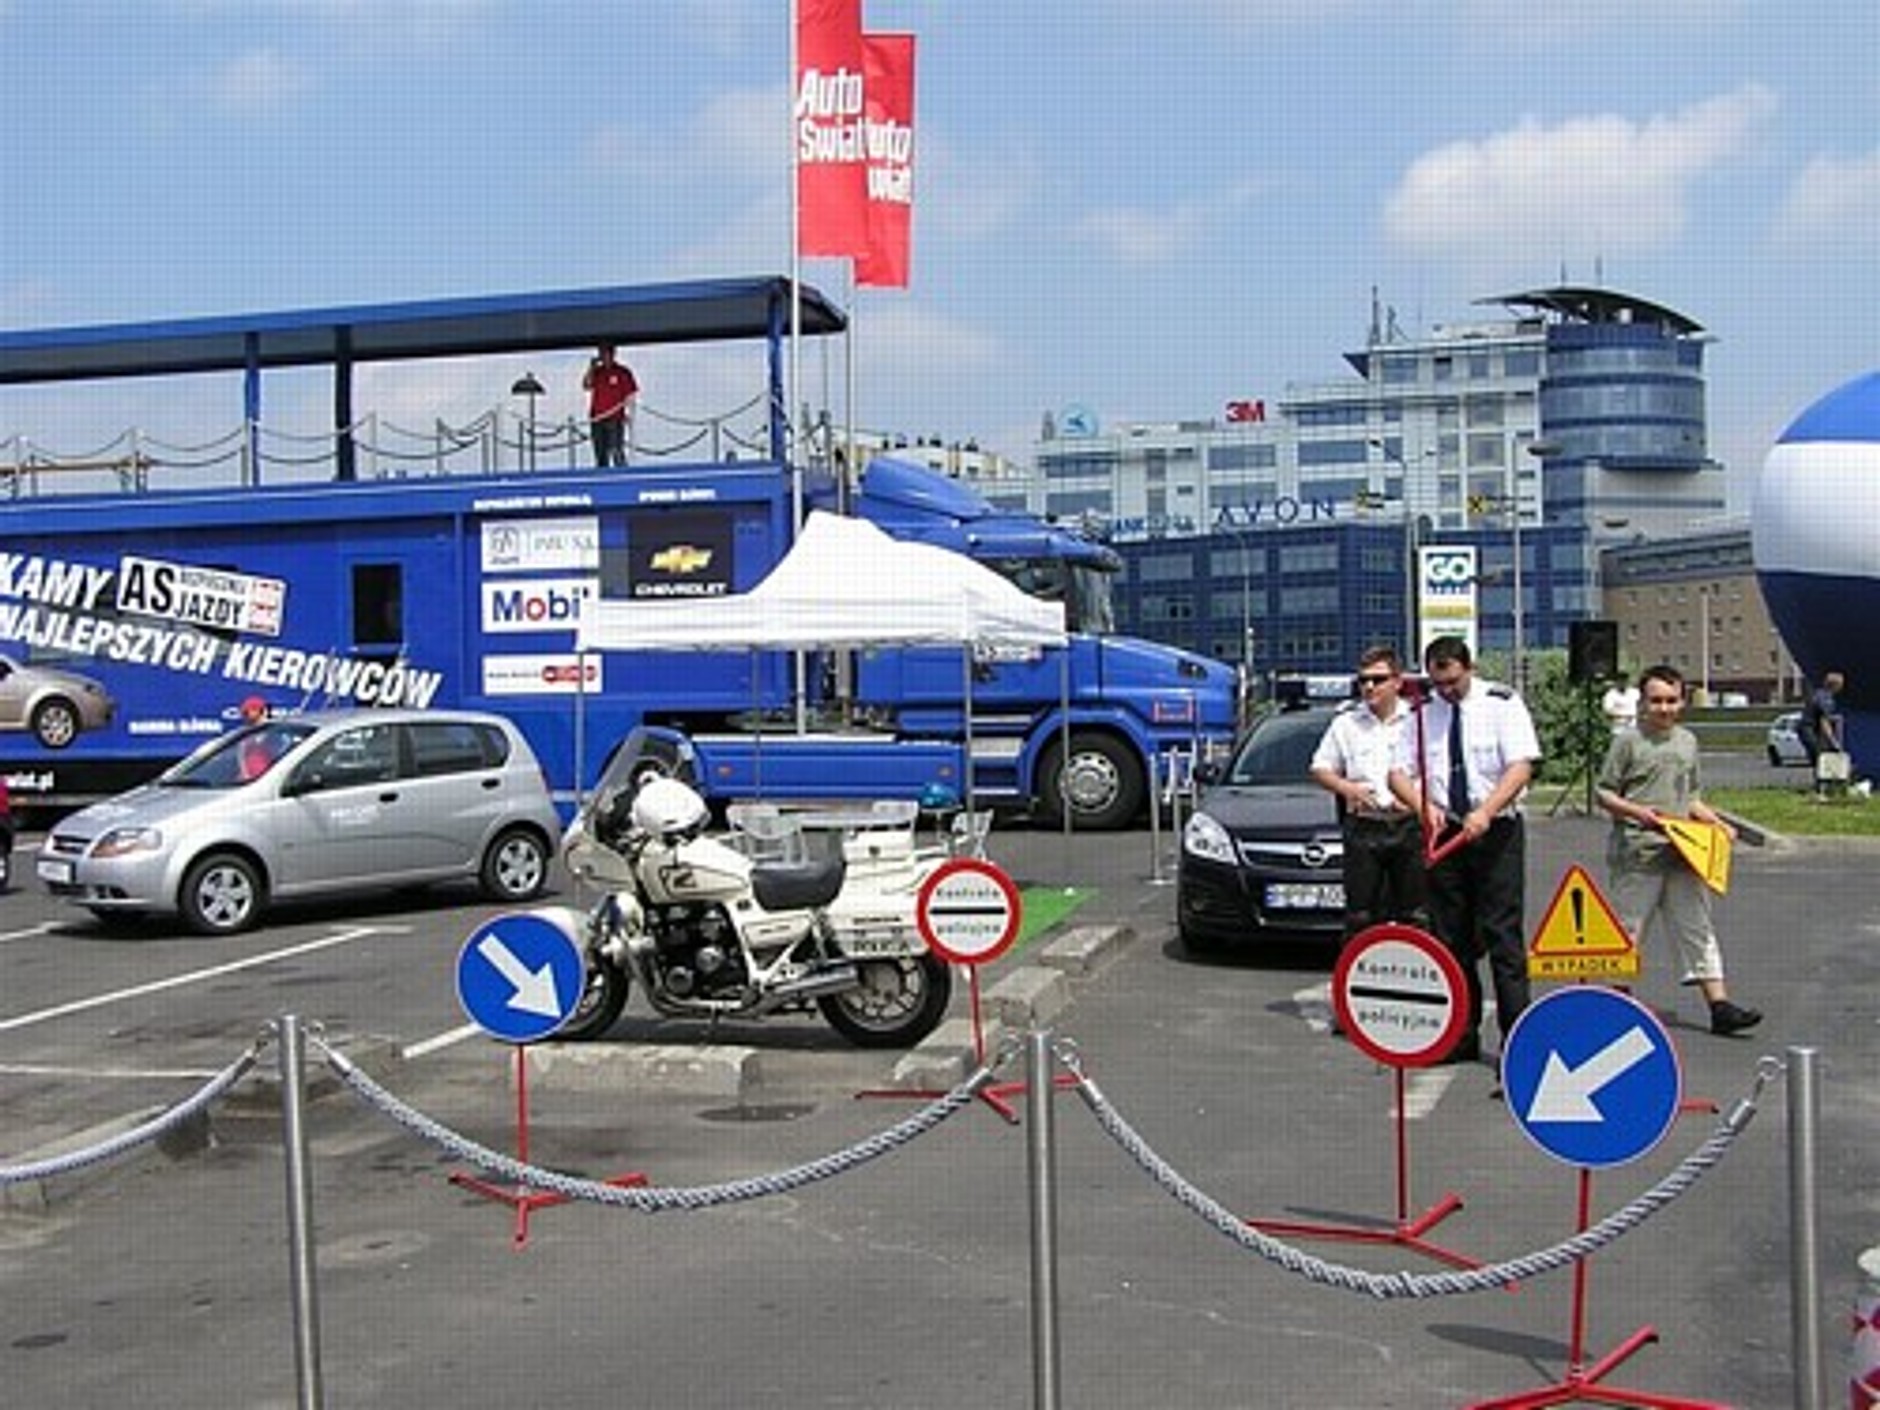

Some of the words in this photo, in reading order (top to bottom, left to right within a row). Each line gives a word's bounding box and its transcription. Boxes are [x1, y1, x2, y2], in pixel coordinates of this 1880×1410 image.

[795, 67, 862, 119] Auto
[1226, 400, 1266, 423] 3M
[1214, 497, 1336, 525] AVON
[0, 552, 114, 609] KAMY
[1428, 555, 1470, 583] GO
[120, 563, 175, 613] AS
[635, 583, 727, 596] CHEVROLET
[174, 590, 246, 626] JAZDY
[0, 605, 218, 674] NAJLEPSZYCH
[222, 641, 443, 709] KIEROWCÓW
